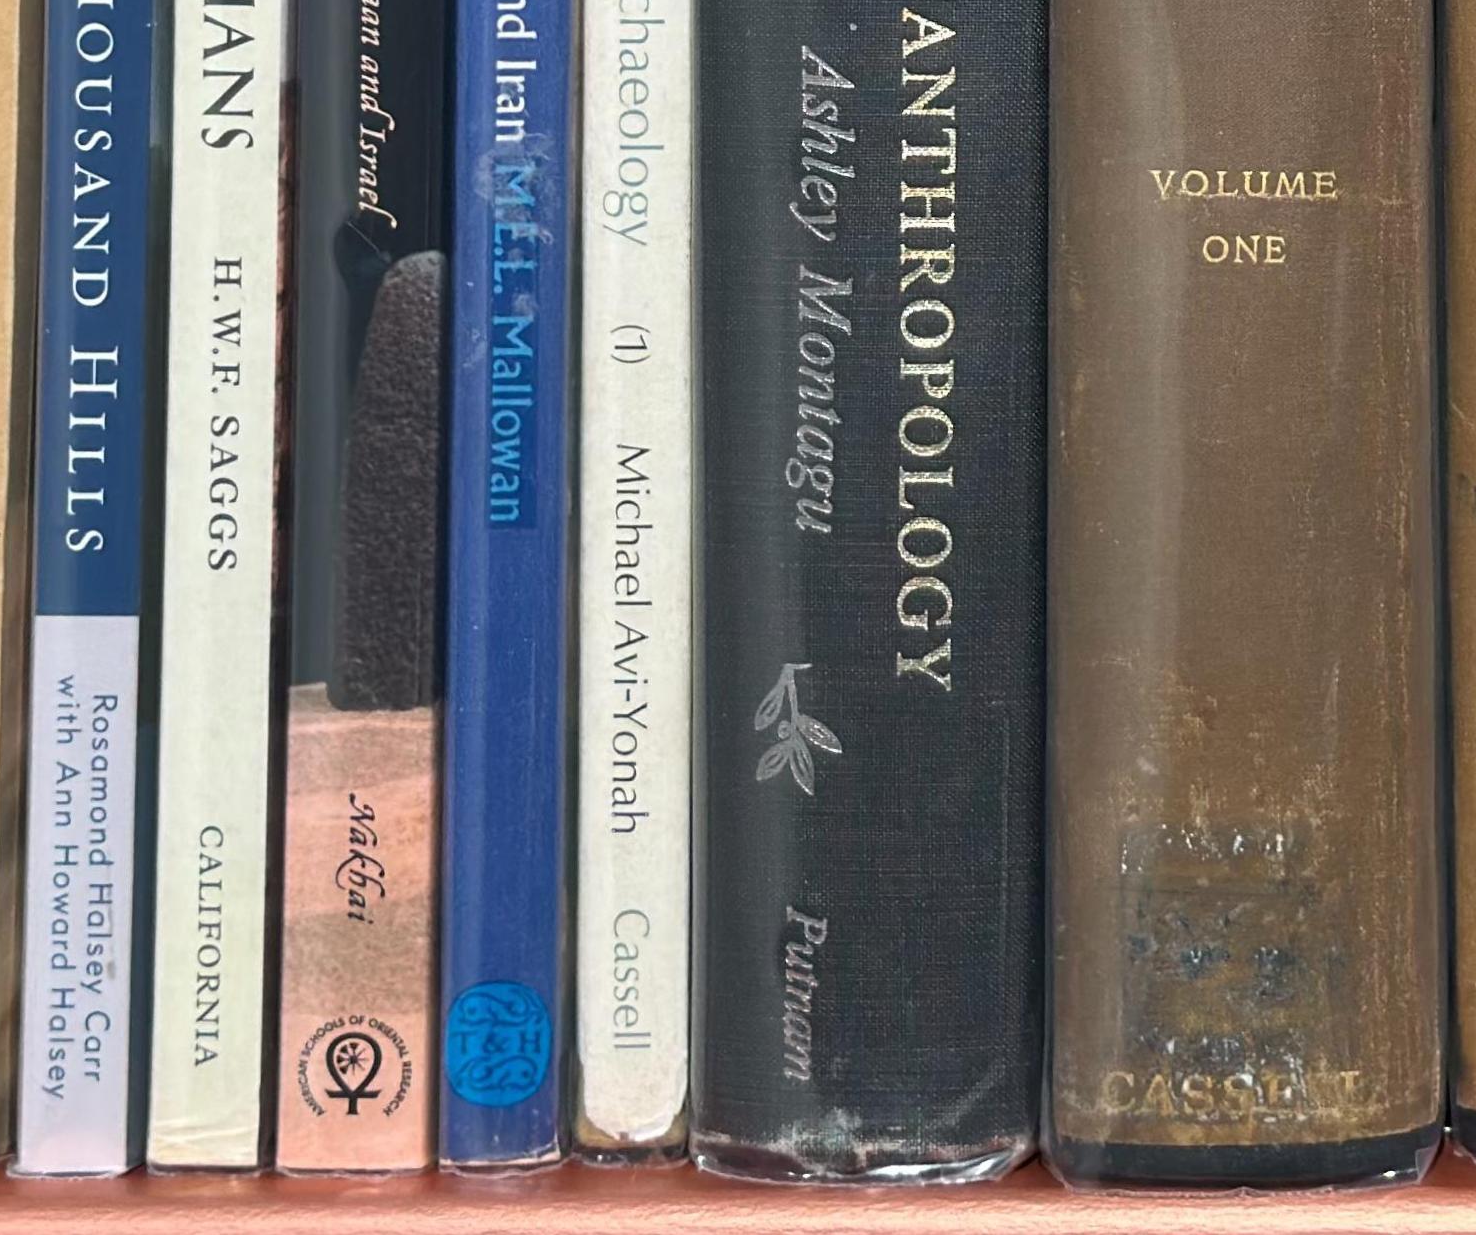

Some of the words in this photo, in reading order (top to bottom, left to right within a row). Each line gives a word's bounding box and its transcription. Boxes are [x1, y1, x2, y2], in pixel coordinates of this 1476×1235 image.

[360, 54, 394, 128] and
[495, 59, 538, 143] Iran
[789, 44, 856, 242] Ashley
[357, 125, 397, 227] Israel
[1148, 170, 1338, 201] VOLUME
[1202, 234, 1286, 264] ONE
[212, 256, 242, 393] H.W.F.
[609, 323, 651, 365] (1)
[896, 9, 956, 692] ANTHROPOLOGY
[65, 344, 118, 552] HILLS
[488, 315, 536, 524] Mallowan
[786, 265, 853, 534] Montagu
[207, 415, 240, 571] SAGGS
[612, 443, 652, 606] Michael
[55, 673, 83, 747] with
[611, 620, 650, 835] Avi-Yonah
[53, 760, 81, 828] Ann
[88, 695, 117, 866] Rosamond
[50, 843, 79, 971] Howard
[334, 792, 385, 924] Nakhai
[80, 882, 114, 995] Halsey
[194, 825, 224, 1067] CALIFORNIA
[612, 908, 651, 1051] Cassell
[785, 905, 829, 1081] Putnam
[40, 986, 75, 1100] Halsey
[81, 1011, 111, 1082] Carr
[304, 1016, 345, 1058] SCHOOLS
[349, 1015, 365, 1025] OF
[368, 1018, 410, 1058] ORIENTAL
[297, 1059, 325, 1116] AMERICAN
[383, 1059, 413, 1116] RESEARCH
